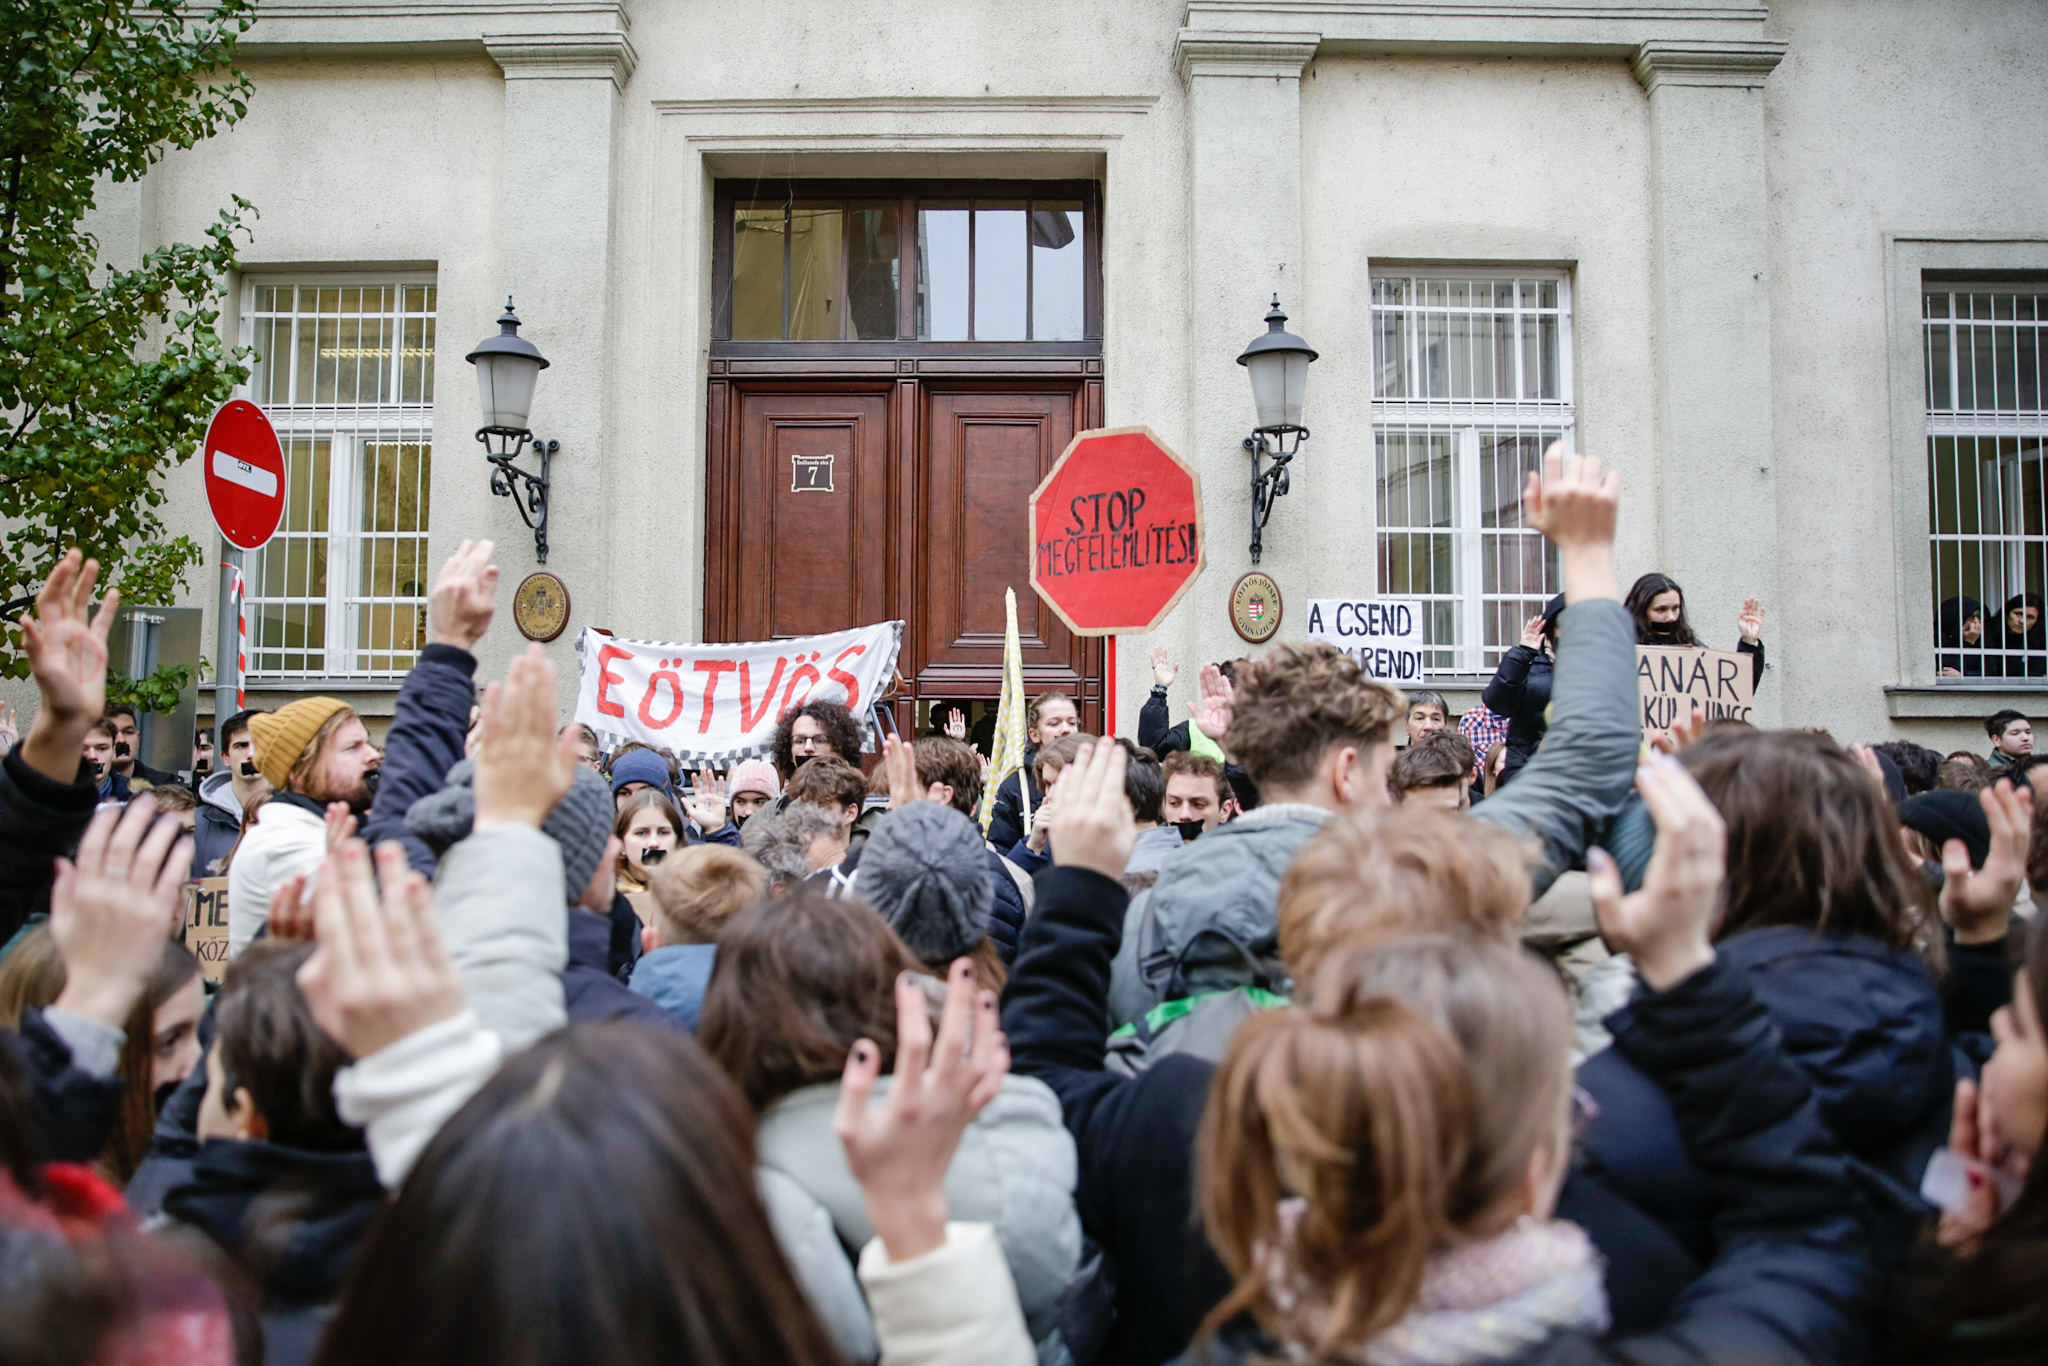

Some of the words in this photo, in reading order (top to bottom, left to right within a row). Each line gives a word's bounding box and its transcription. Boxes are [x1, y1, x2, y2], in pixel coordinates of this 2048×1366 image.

[808, 466, 818, 485] 7
[1065, 488, 1146, 536] STOP
[1038, 520, 1196, 578] MEGFÉLEMLÍTÉS!
[1236, 577, 1258, 605] EÖTVÖS
[1258, 577, 1278, 605] JÓZSEF
[1238, 617, 1275, 635] GIMNÁZIUM
[1309, 603, 1324, 633] A
[1336, 602, 1412, 636] CSEND
[1360, 647, 1422, 680] REND!
[596, 644, 867, 733] EÖTVÖS
[196, 937, 229, 961] KÖZ
